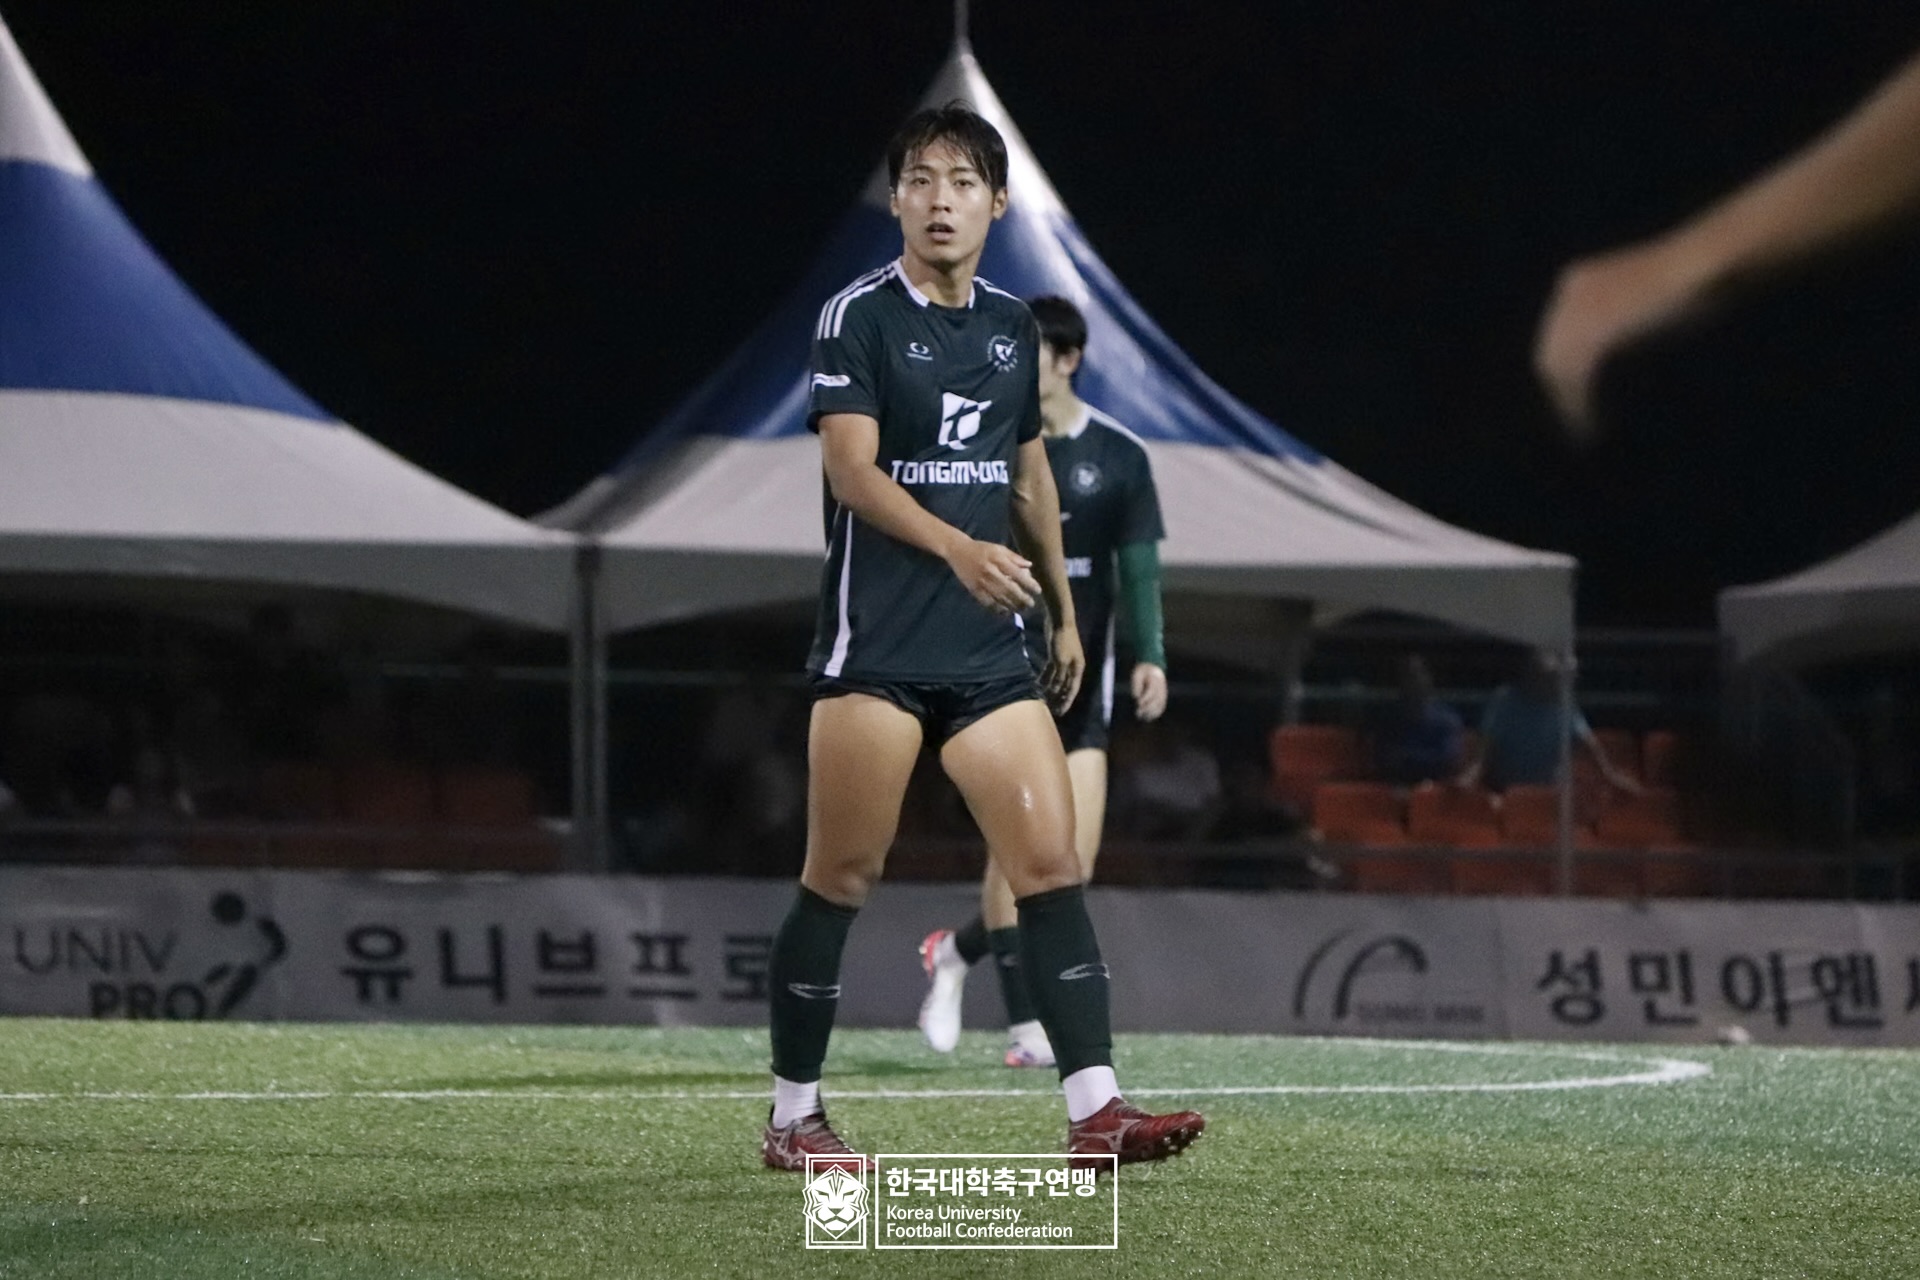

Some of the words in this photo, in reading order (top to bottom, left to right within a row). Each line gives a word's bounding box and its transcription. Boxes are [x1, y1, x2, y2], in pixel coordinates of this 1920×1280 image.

[14, 926, 178, 974] UNIV
[340, 924, 770, 1003] 유니브프로
[90, 982, 207, 1018] PRO
